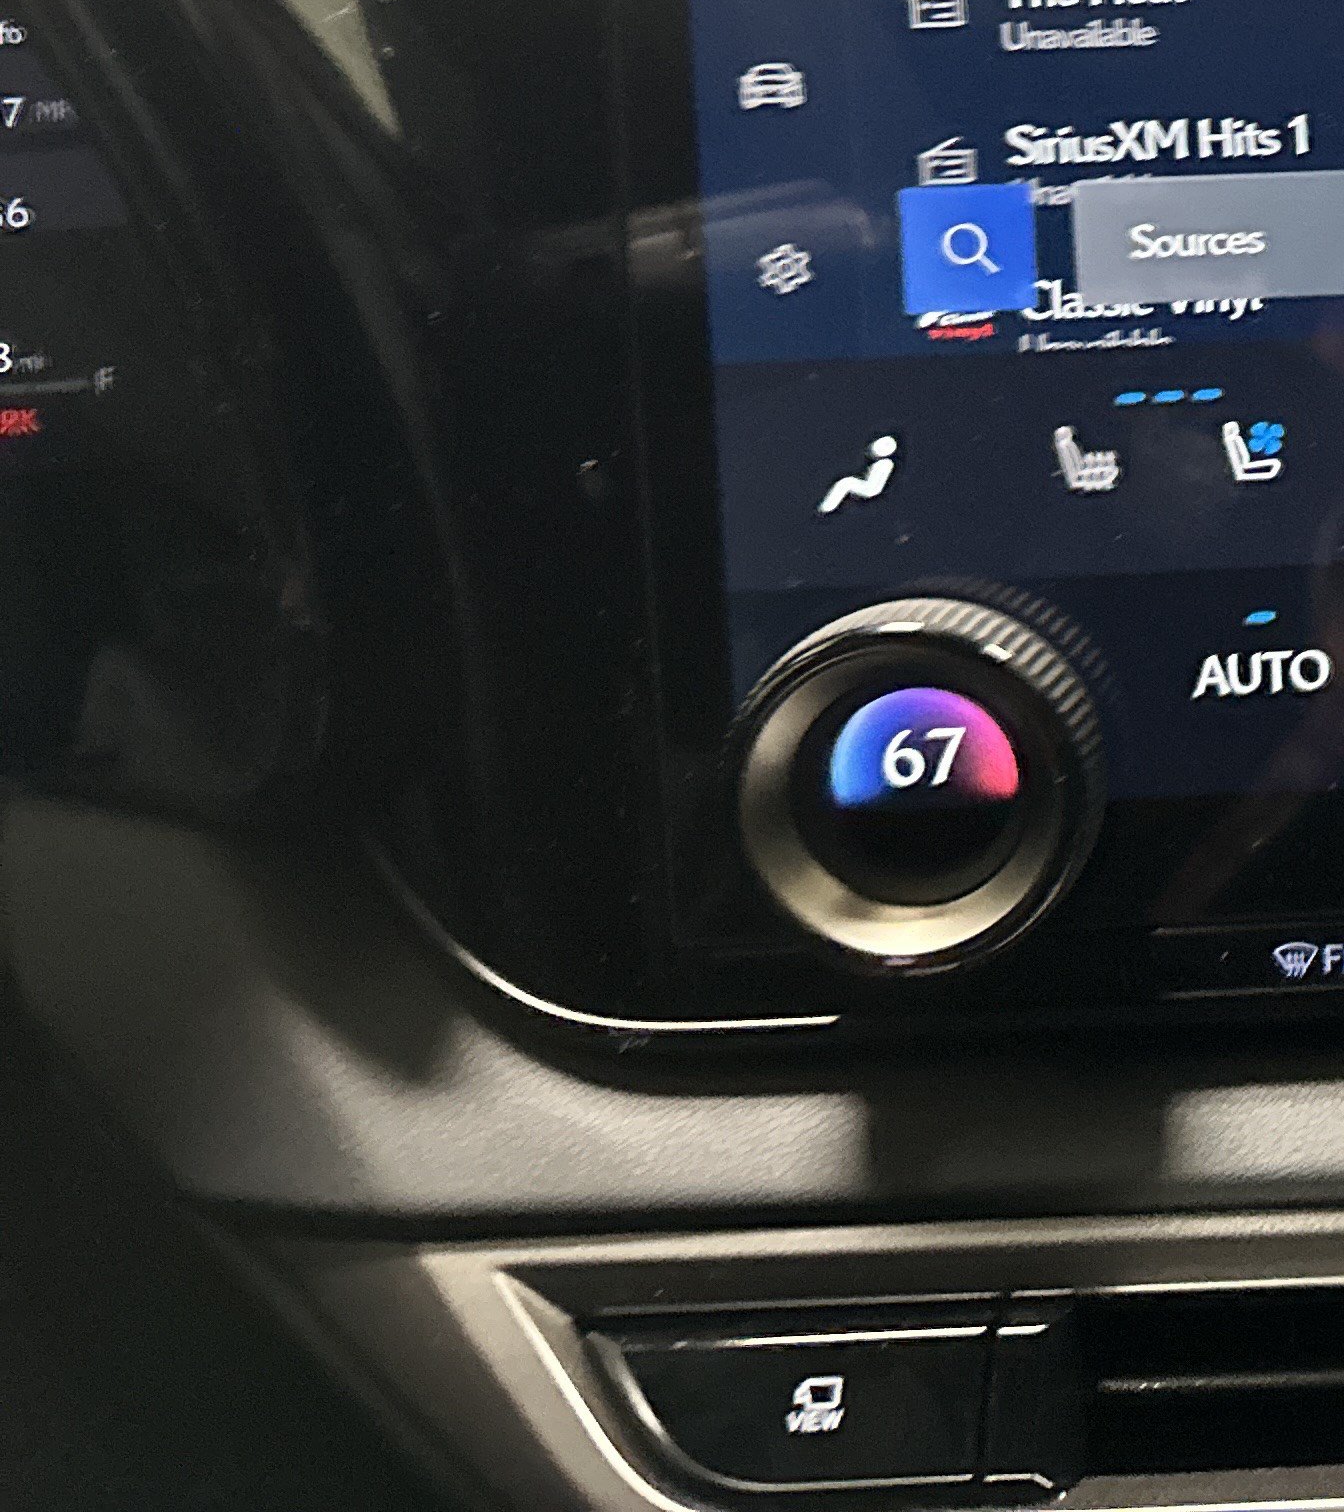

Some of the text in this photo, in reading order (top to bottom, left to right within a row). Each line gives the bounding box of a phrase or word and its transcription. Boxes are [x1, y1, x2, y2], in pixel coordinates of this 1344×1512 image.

[1000, 20, 1158, 53] Unavailable
[1004, 116, 1312, 168] SiriusXM Hits 1
[1128, 224, 1268, 261] Sources
[1192, 648, 1332, 699] AUTO
[880, 727, 966, 788] 67
[785, 1409, 843, 1432] VIEW
